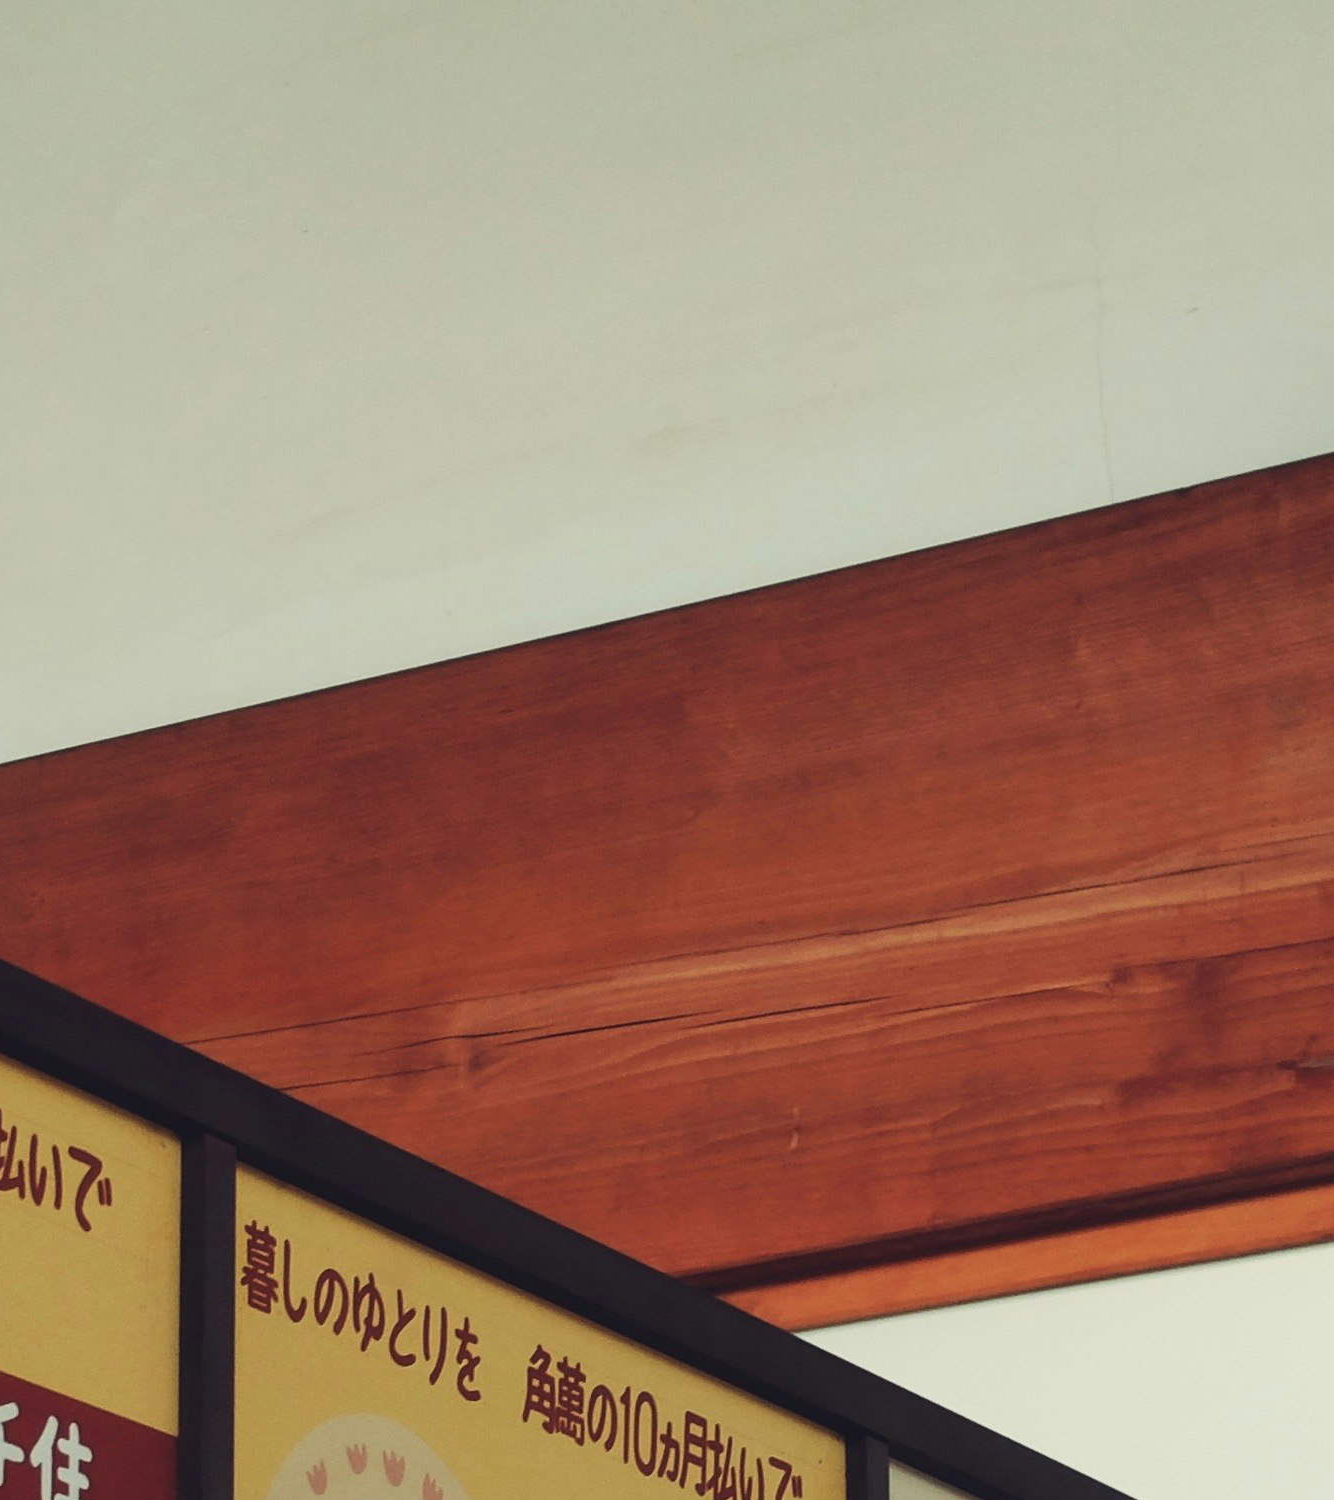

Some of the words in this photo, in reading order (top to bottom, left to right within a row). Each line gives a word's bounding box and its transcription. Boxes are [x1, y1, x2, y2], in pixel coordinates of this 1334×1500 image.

[241, 1220, 481, 1401] 暮しのゆとりを
